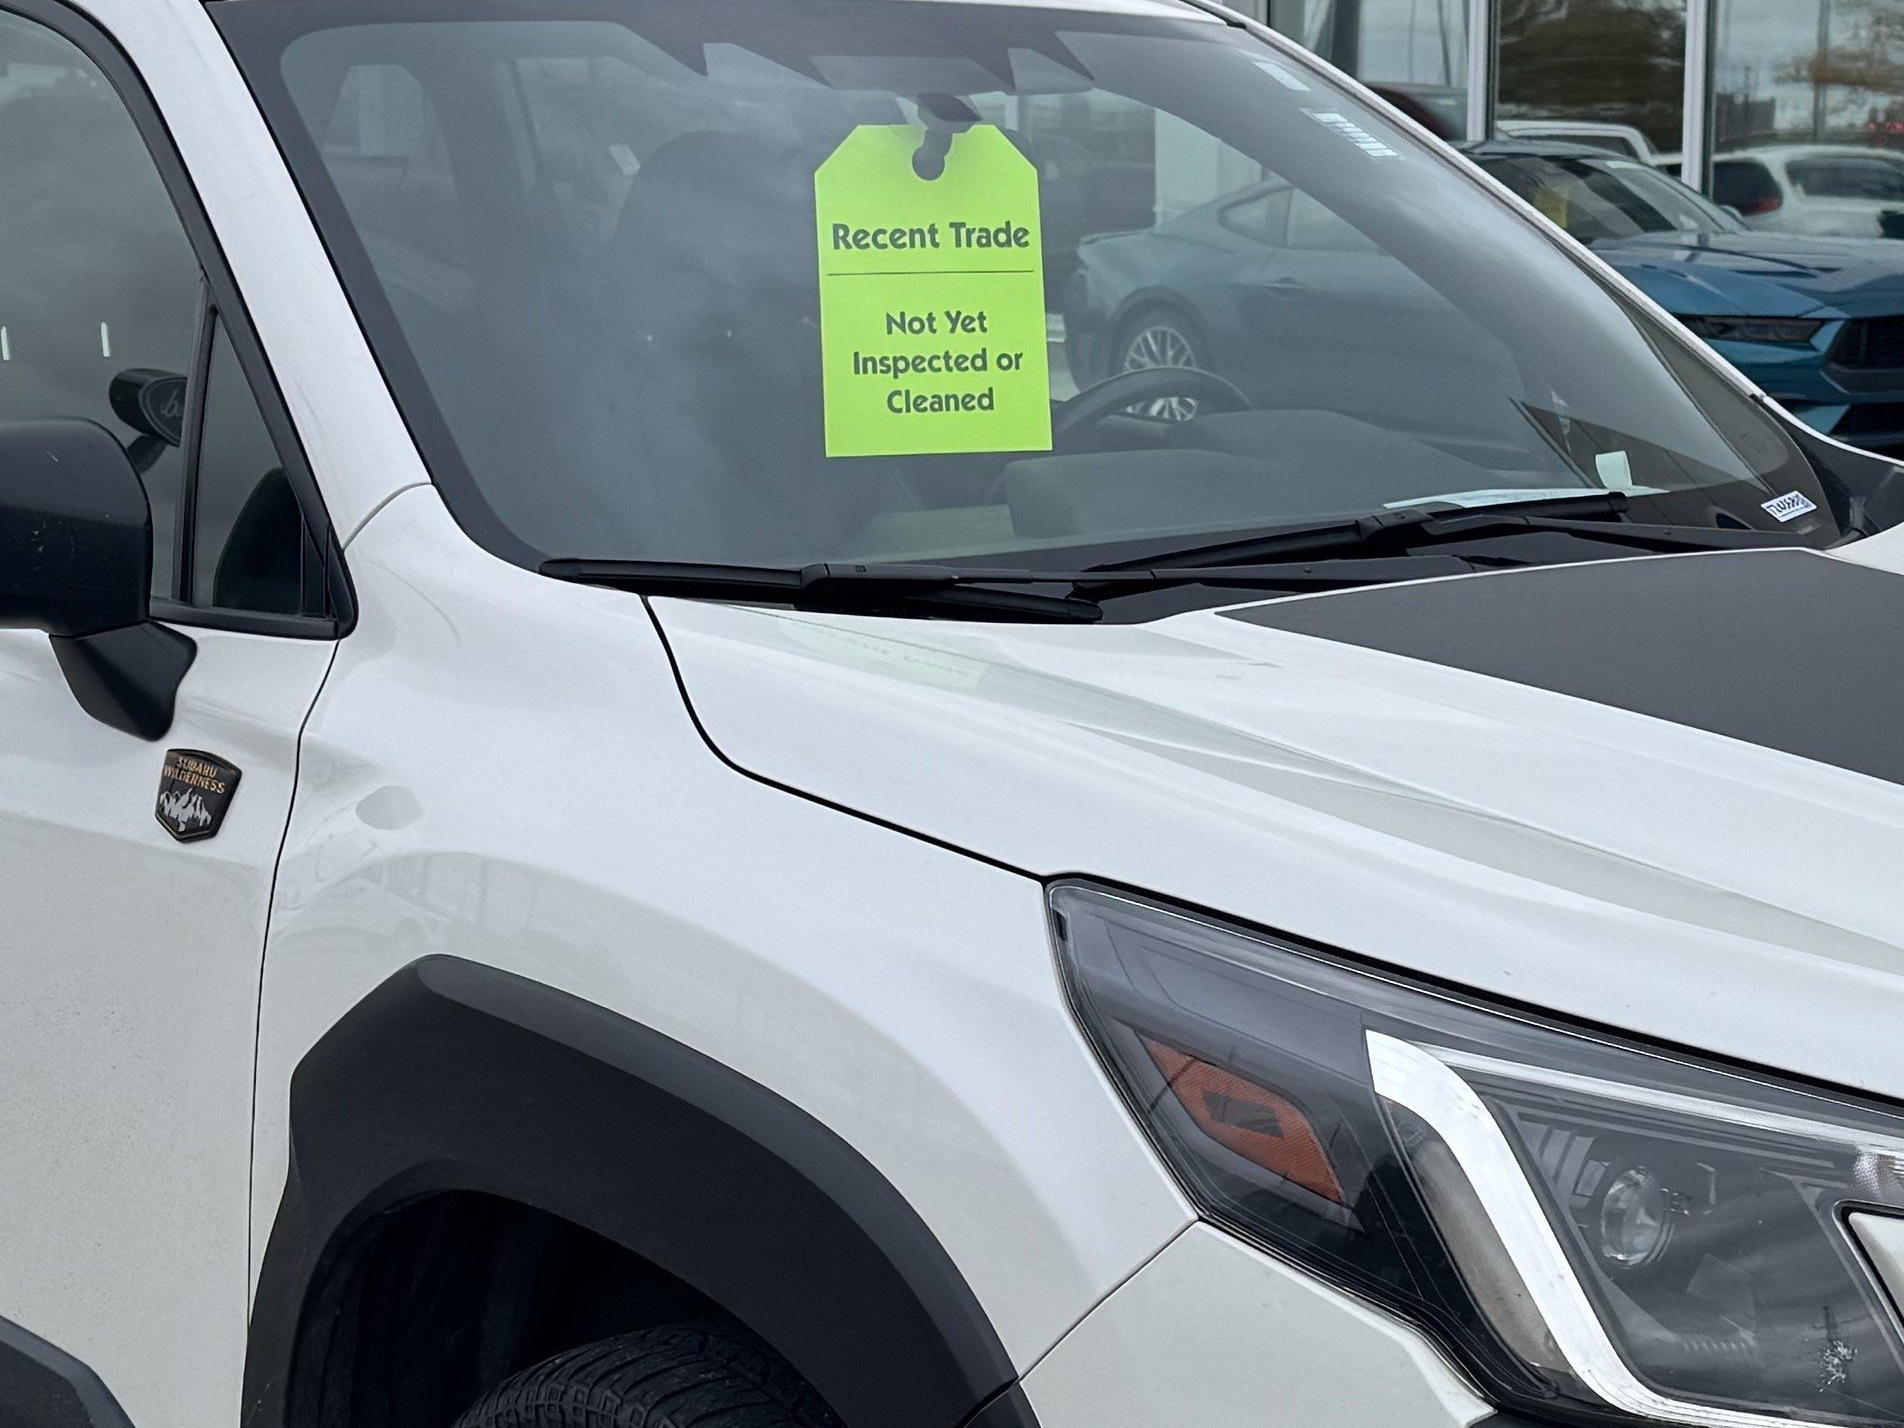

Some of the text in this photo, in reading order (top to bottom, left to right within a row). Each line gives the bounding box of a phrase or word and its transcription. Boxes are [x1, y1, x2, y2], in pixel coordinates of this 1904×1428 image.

[832, 220, 1031, 251] Recent Trade
[885, 309, 989, 336] Not Yet
[853, 347, 1024, 380] Inspected or
[886, 387, 996, 414] Cleaned
[163, 764, 226, 795] WILDERNESS
[176, 756, 218, 778] SUBARU
